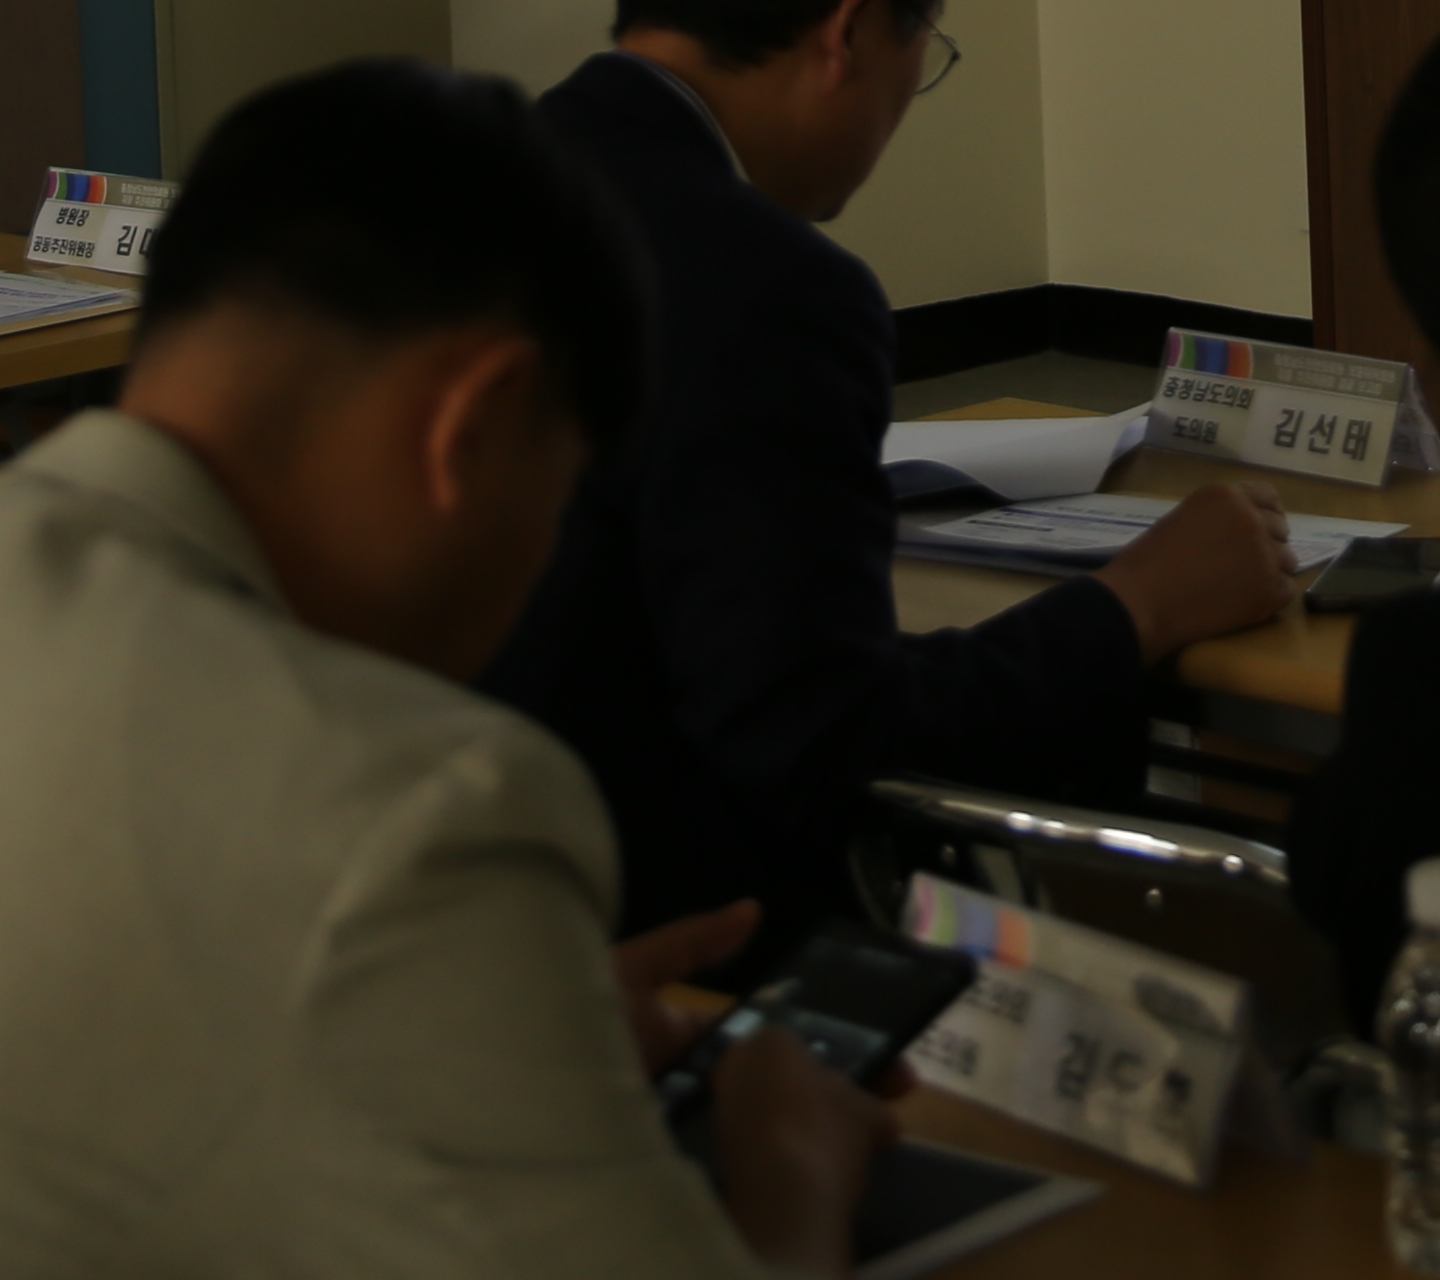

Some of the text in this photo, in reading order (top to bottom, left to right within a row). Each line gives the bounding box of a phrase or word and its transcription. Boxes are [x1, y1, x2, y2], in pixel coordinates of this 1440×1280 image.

[56, 207, 90, 227] 병원장
[33, 236, 95, 258] 공동추진위원장
[1162, 376, 1255, 410] 충청남도의회
[1173, 416, 1220, 444] 도의원
[1274, 409, 1373, 461] 김선태
